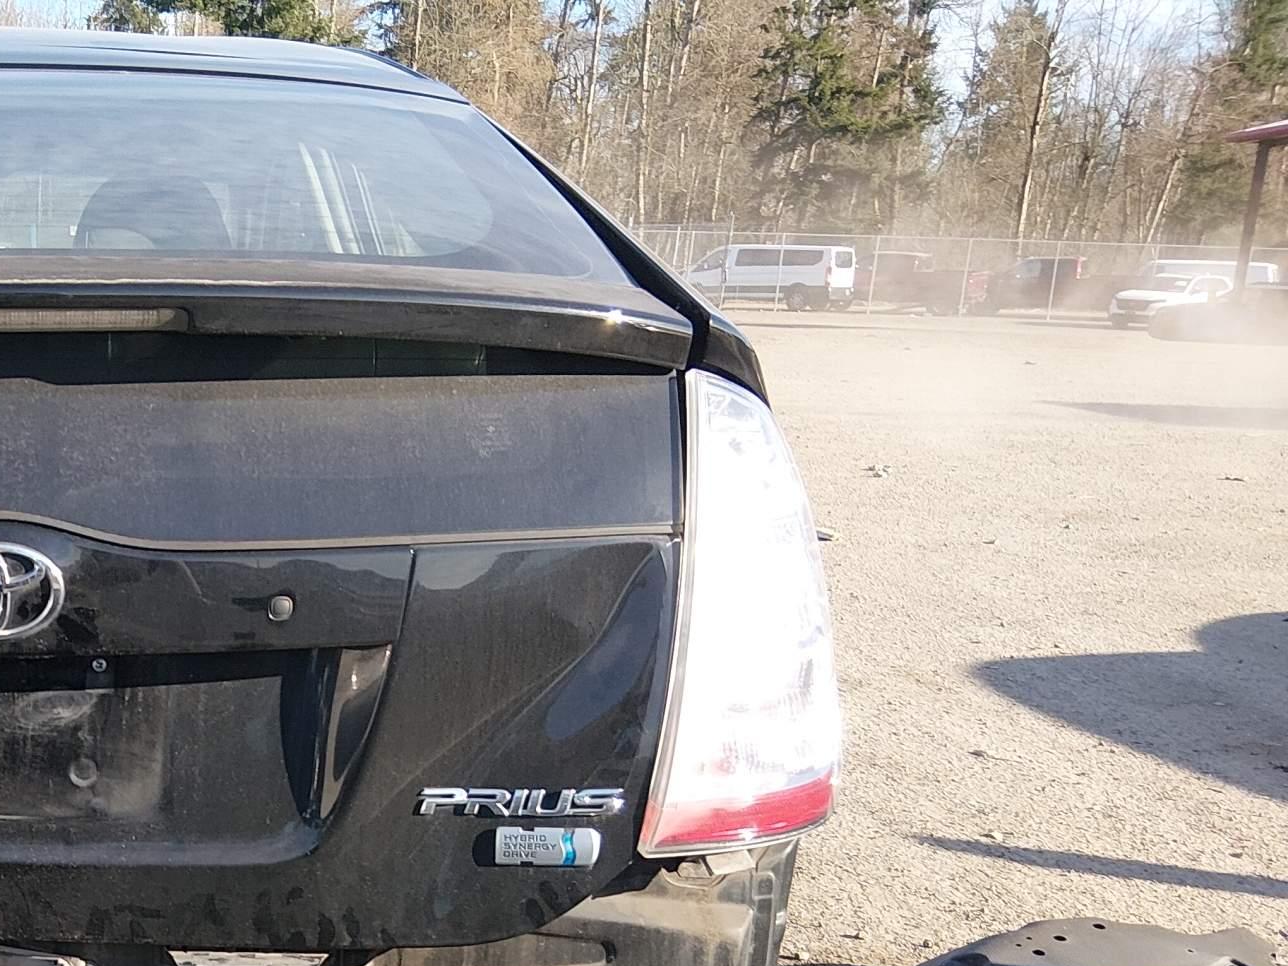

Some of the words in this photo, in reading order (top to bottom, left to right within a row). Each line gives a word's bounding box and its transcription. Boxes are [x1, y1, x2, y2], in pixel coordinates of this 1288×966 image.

[416, 787, 625, 817] PRIUS
[503, 834, 547, 843] HYBRID
[503, 842, 557, 851] SYNERGY
[503, 851, 537, 859] DRIVE
